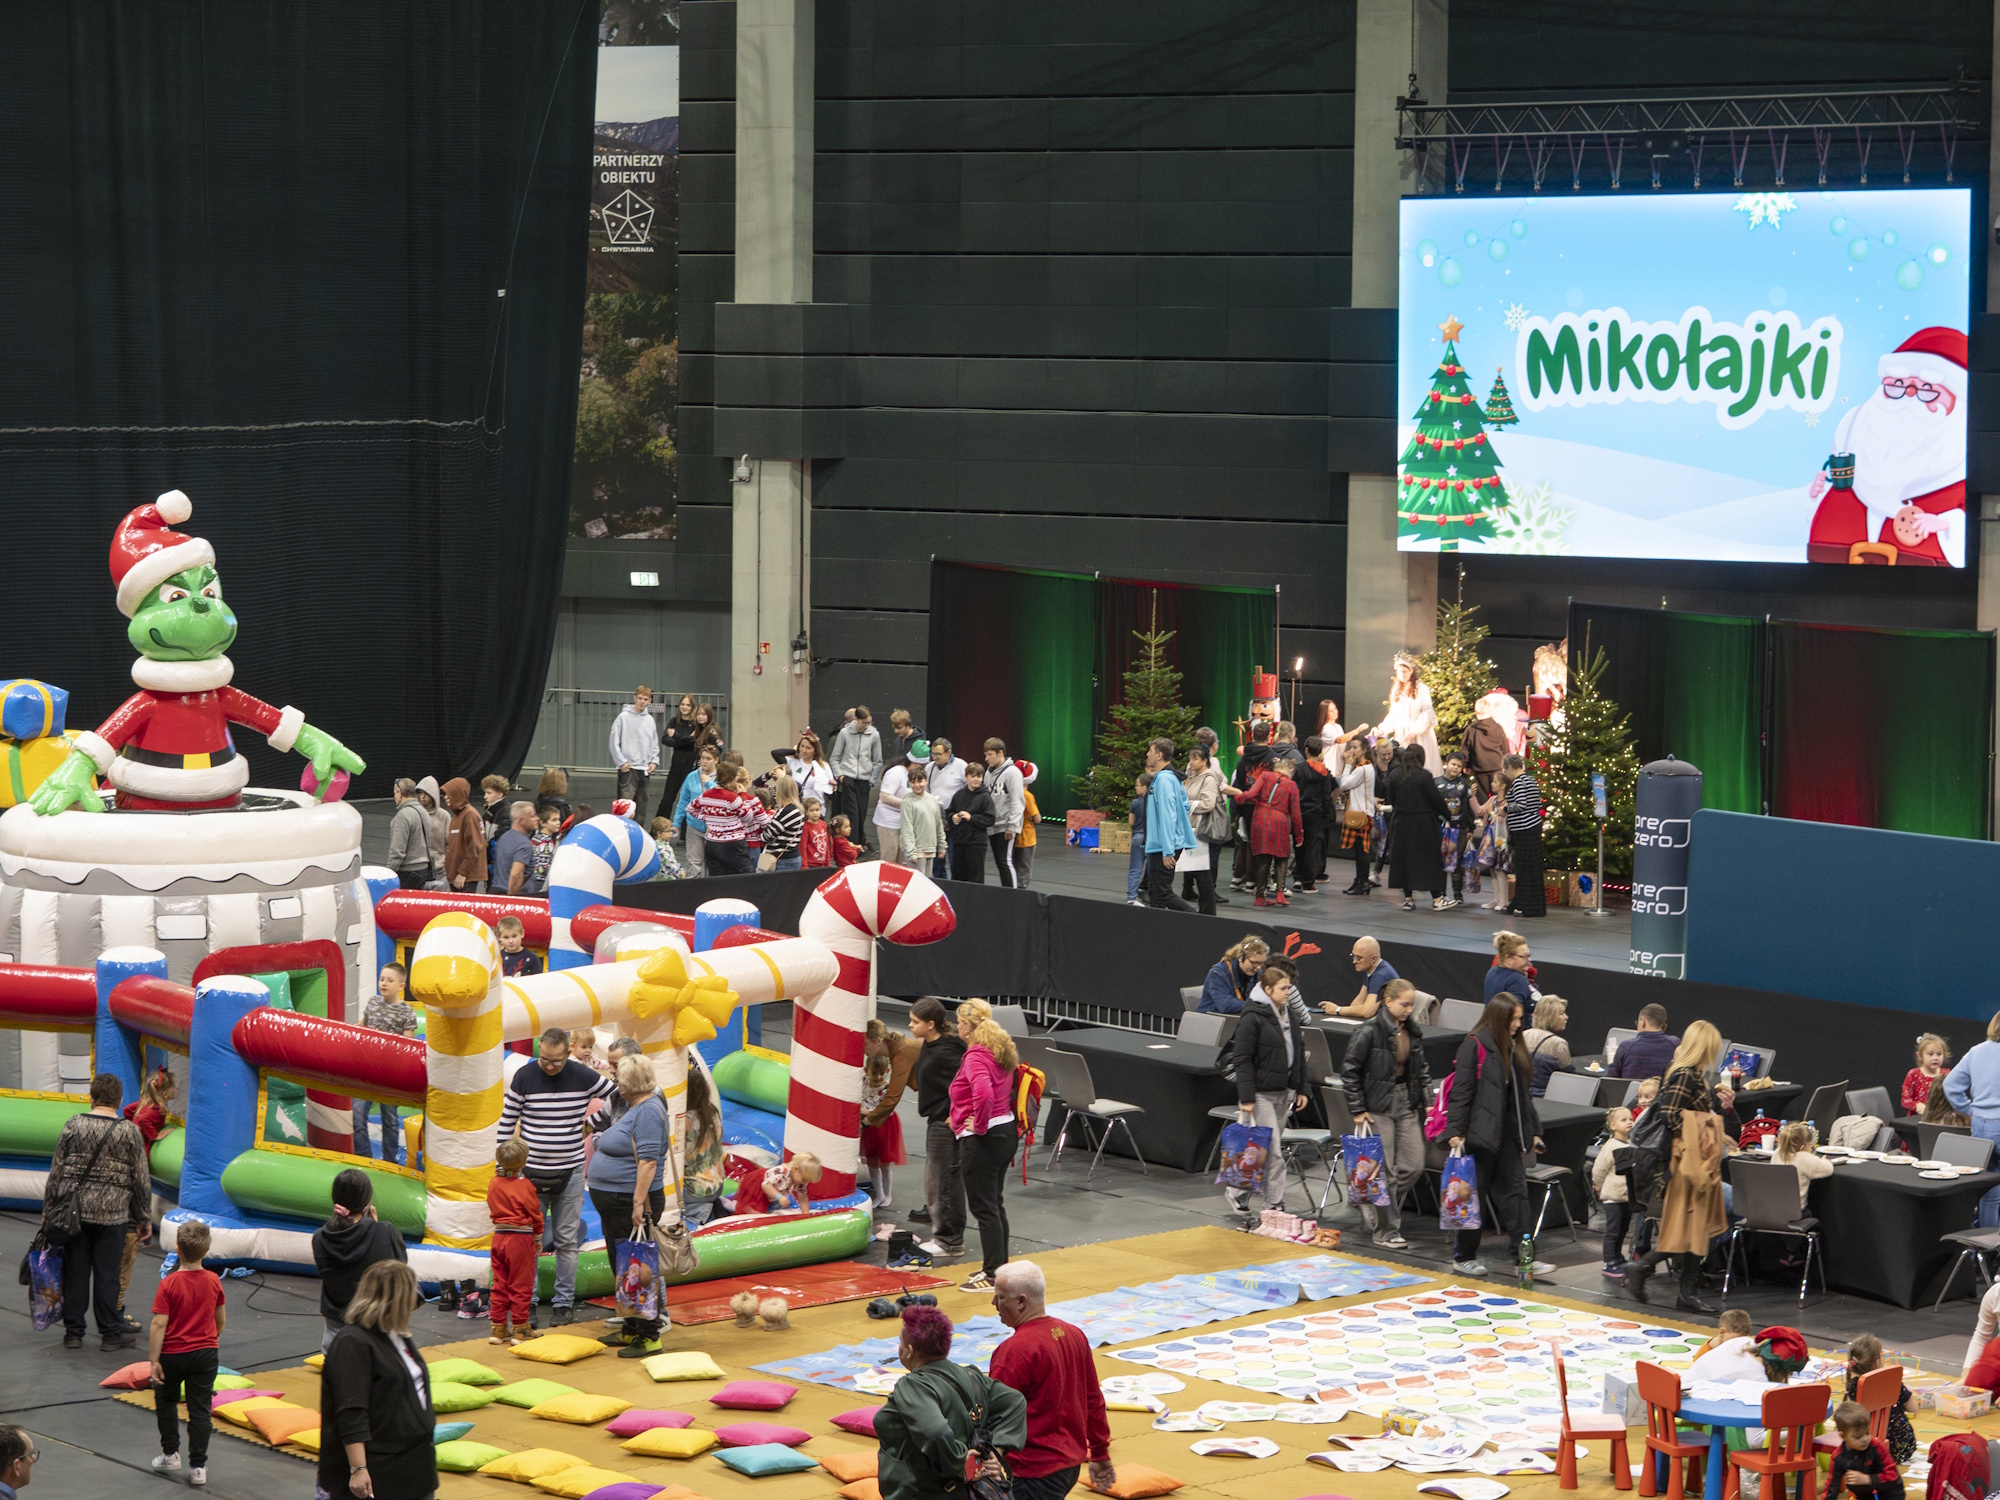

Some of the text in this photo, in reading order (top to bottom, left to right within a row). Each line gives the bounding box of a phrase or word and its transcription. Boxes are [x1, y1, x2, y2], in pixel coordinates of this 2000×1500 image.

[593, 154, 665, 167] PARTNERZY
[600, 171, 656, 184] OBIEKTU
[1526, 318, 1831, 418] Mikołajki
[1634, 814, 1660, 830] pre
[1634, 831, 1673, 848] zero
[1632, 881, 1657, 897] pre
[1631, 899, 1670, 915] zero
